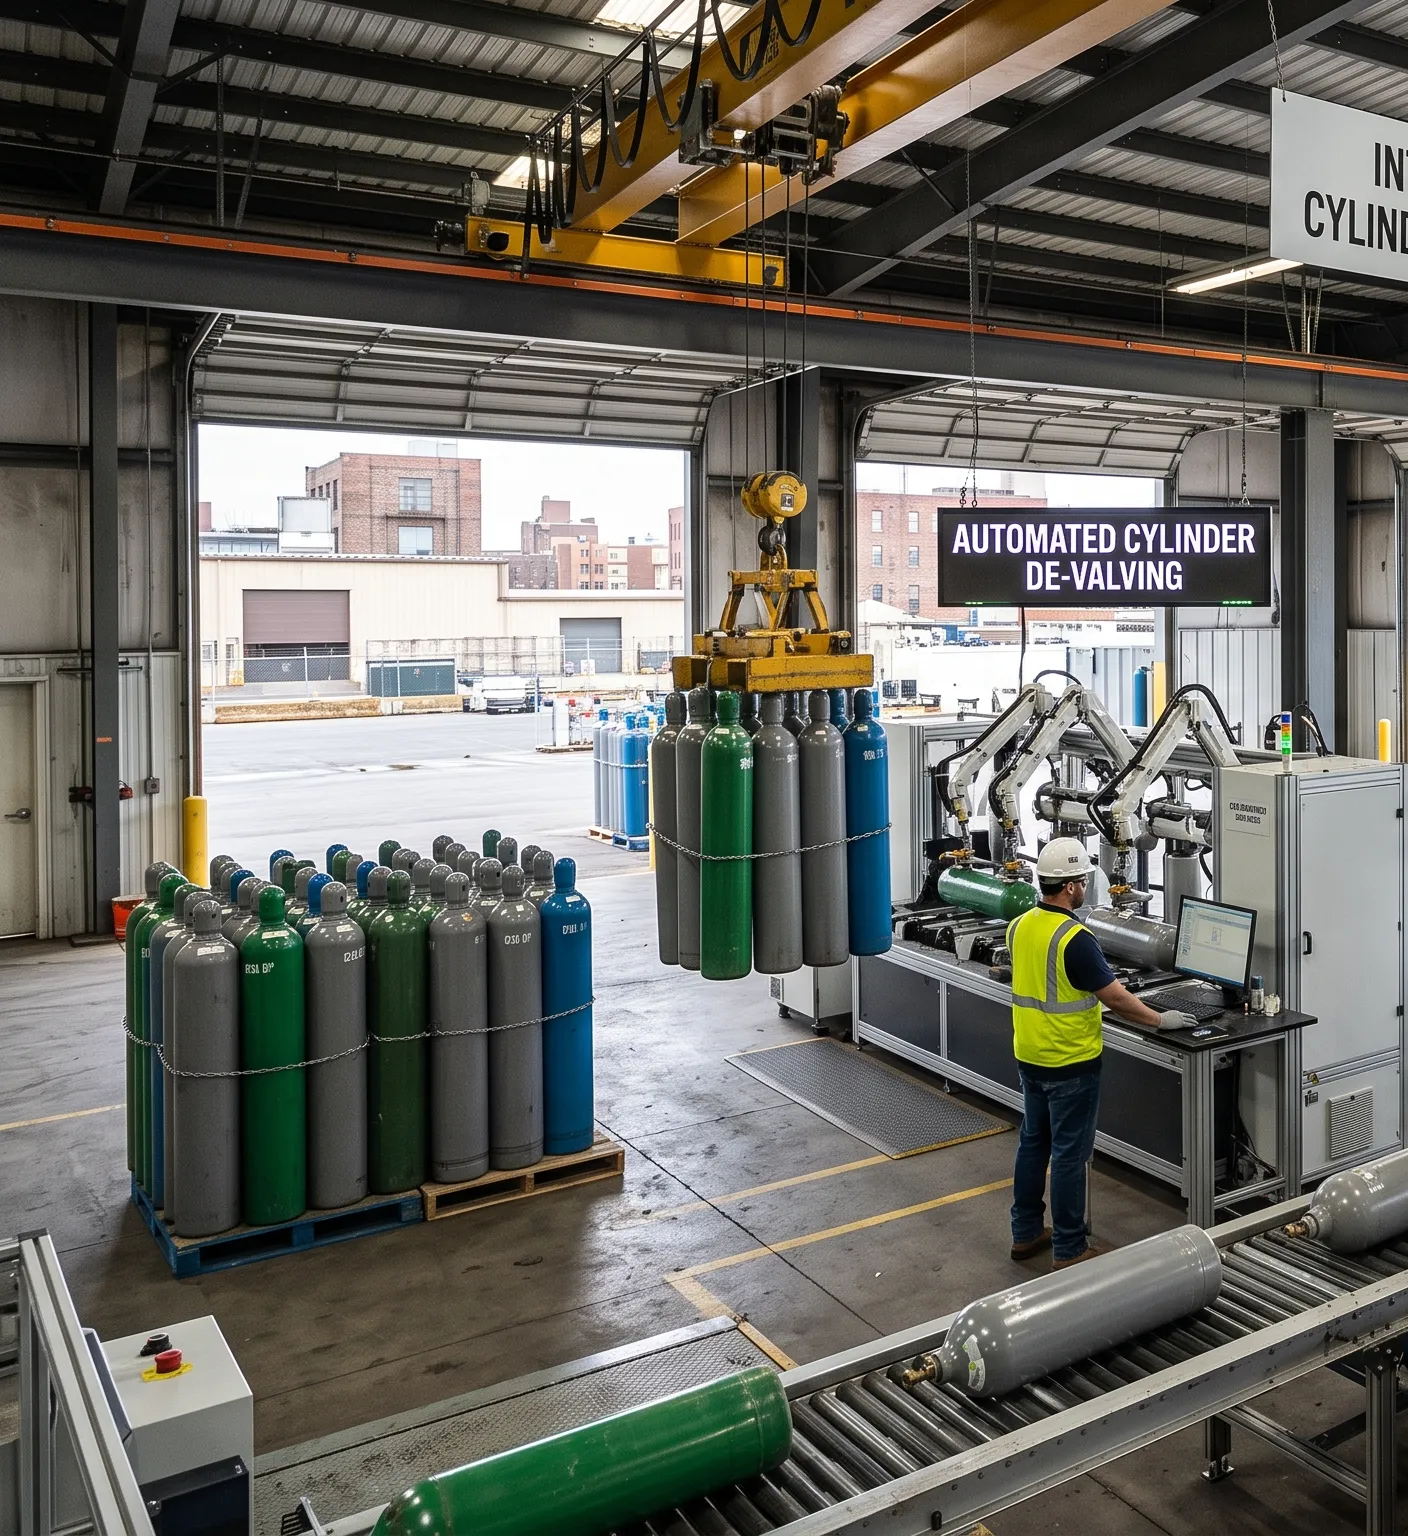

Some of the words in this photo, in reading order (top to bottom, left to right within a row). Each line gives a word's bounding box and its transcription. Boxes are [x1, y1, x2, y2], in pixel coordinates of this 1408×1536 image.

[952, 523, 1117, 554] AUTOMATED
[1124, 523, 1256, 554] CYLINDER
[1026, 560, 1183, 591] DE-VALVING
